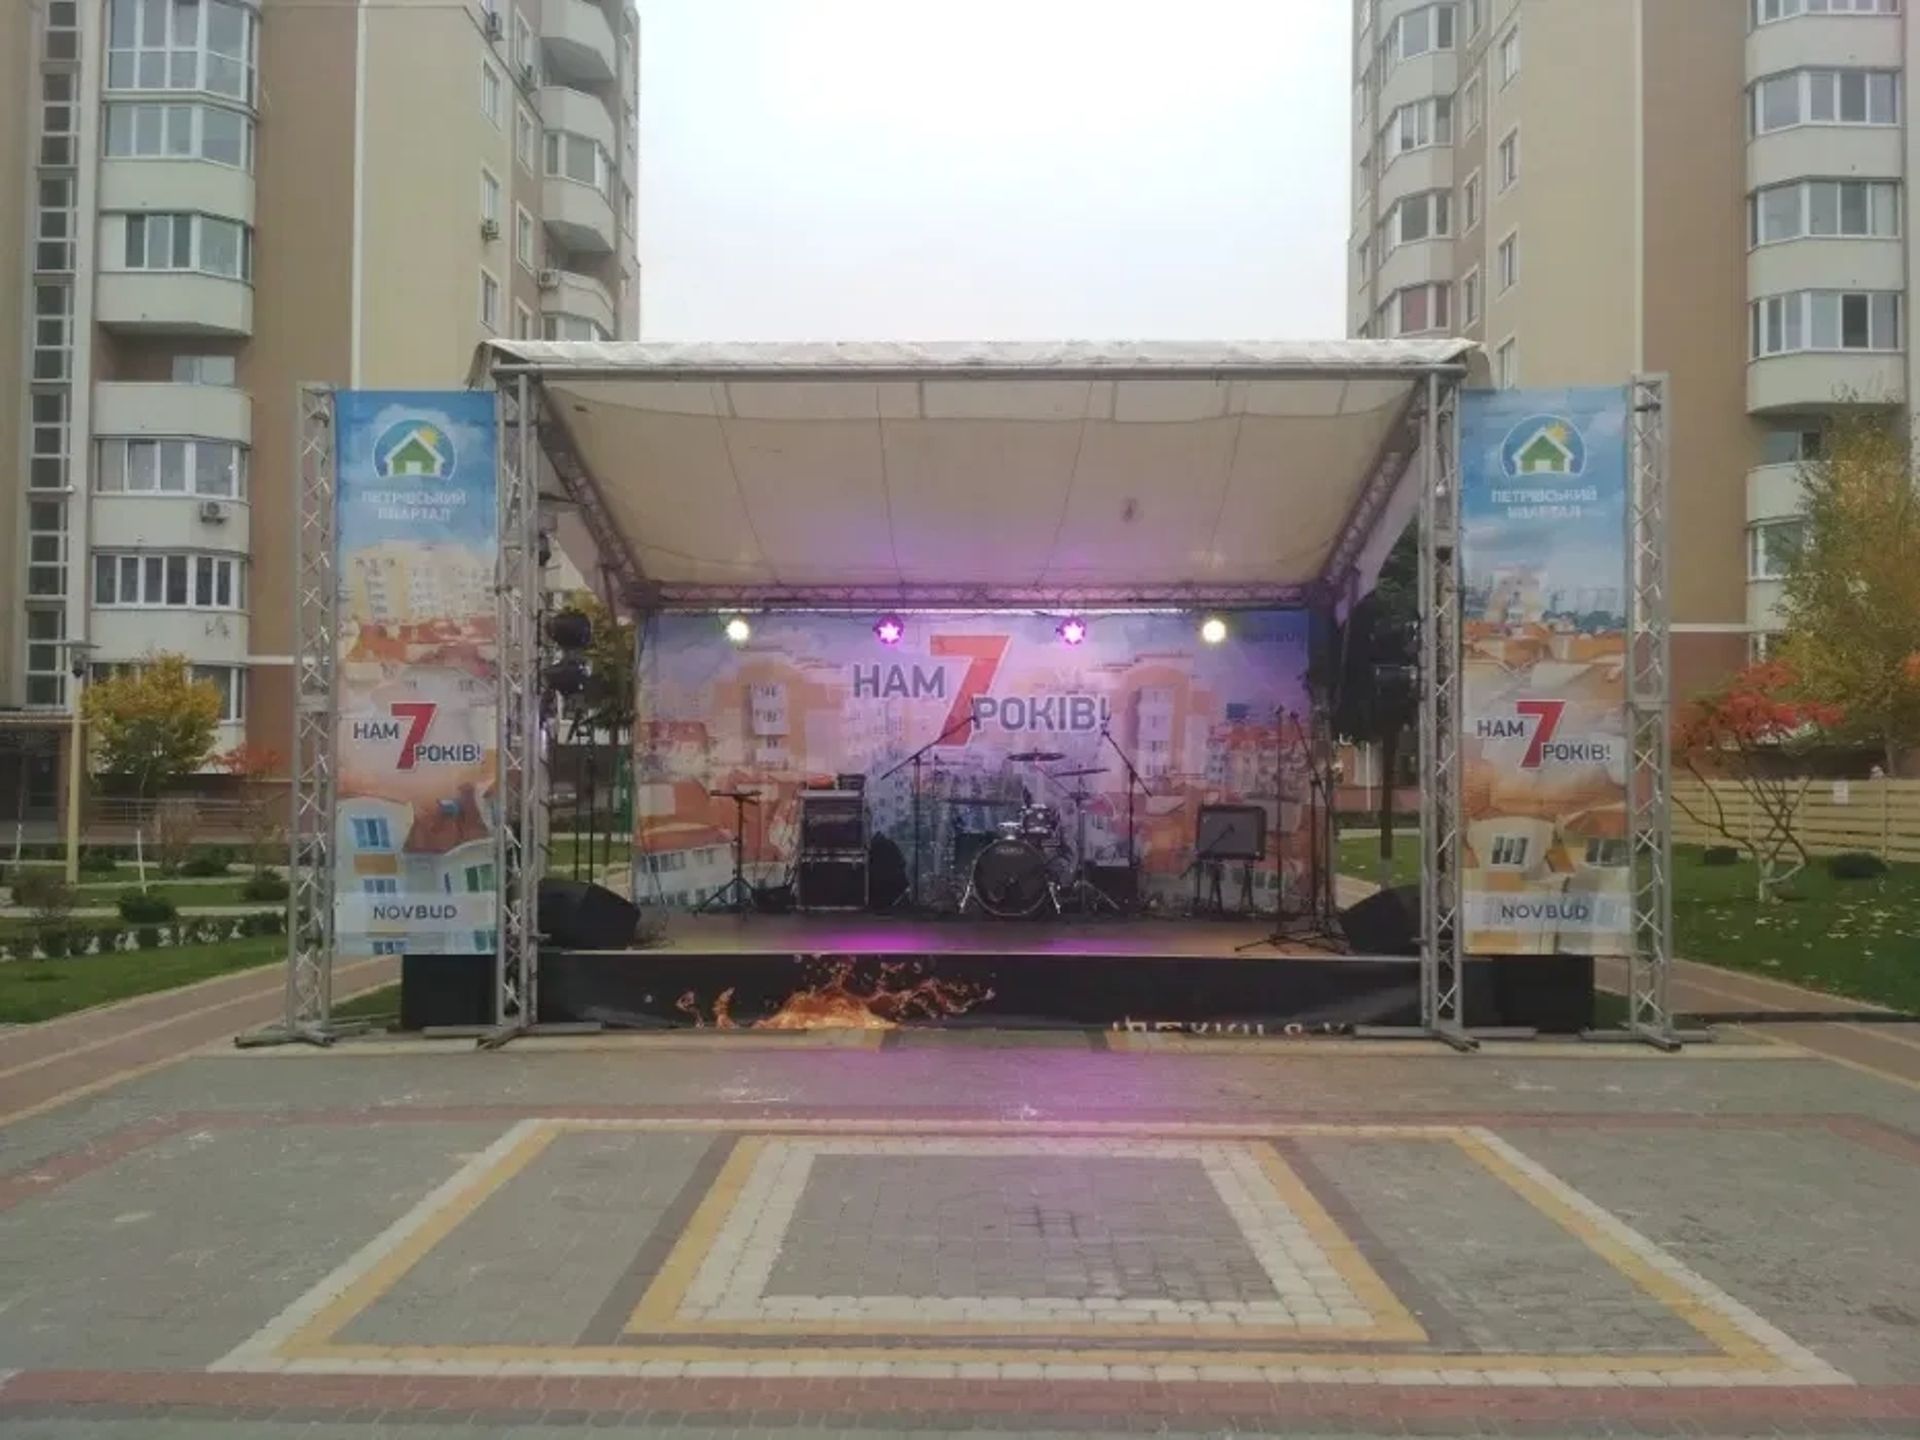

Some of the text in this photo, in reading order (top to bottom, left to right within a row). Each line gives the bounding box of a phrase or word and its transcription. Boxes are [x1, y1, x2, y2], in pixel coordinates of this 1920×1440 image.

[852, 634, 1108, 748] НАМ 7 РОКІВ!
[353, 702, 482, 770] НАМ 7 РОКІВ!
[1476, 700, 1612, 768] НАМ 7 РОКІВ!
[372, 904, 458, 920] NOVBUD
[1500, 904, 1590, 920] NOVBUD
